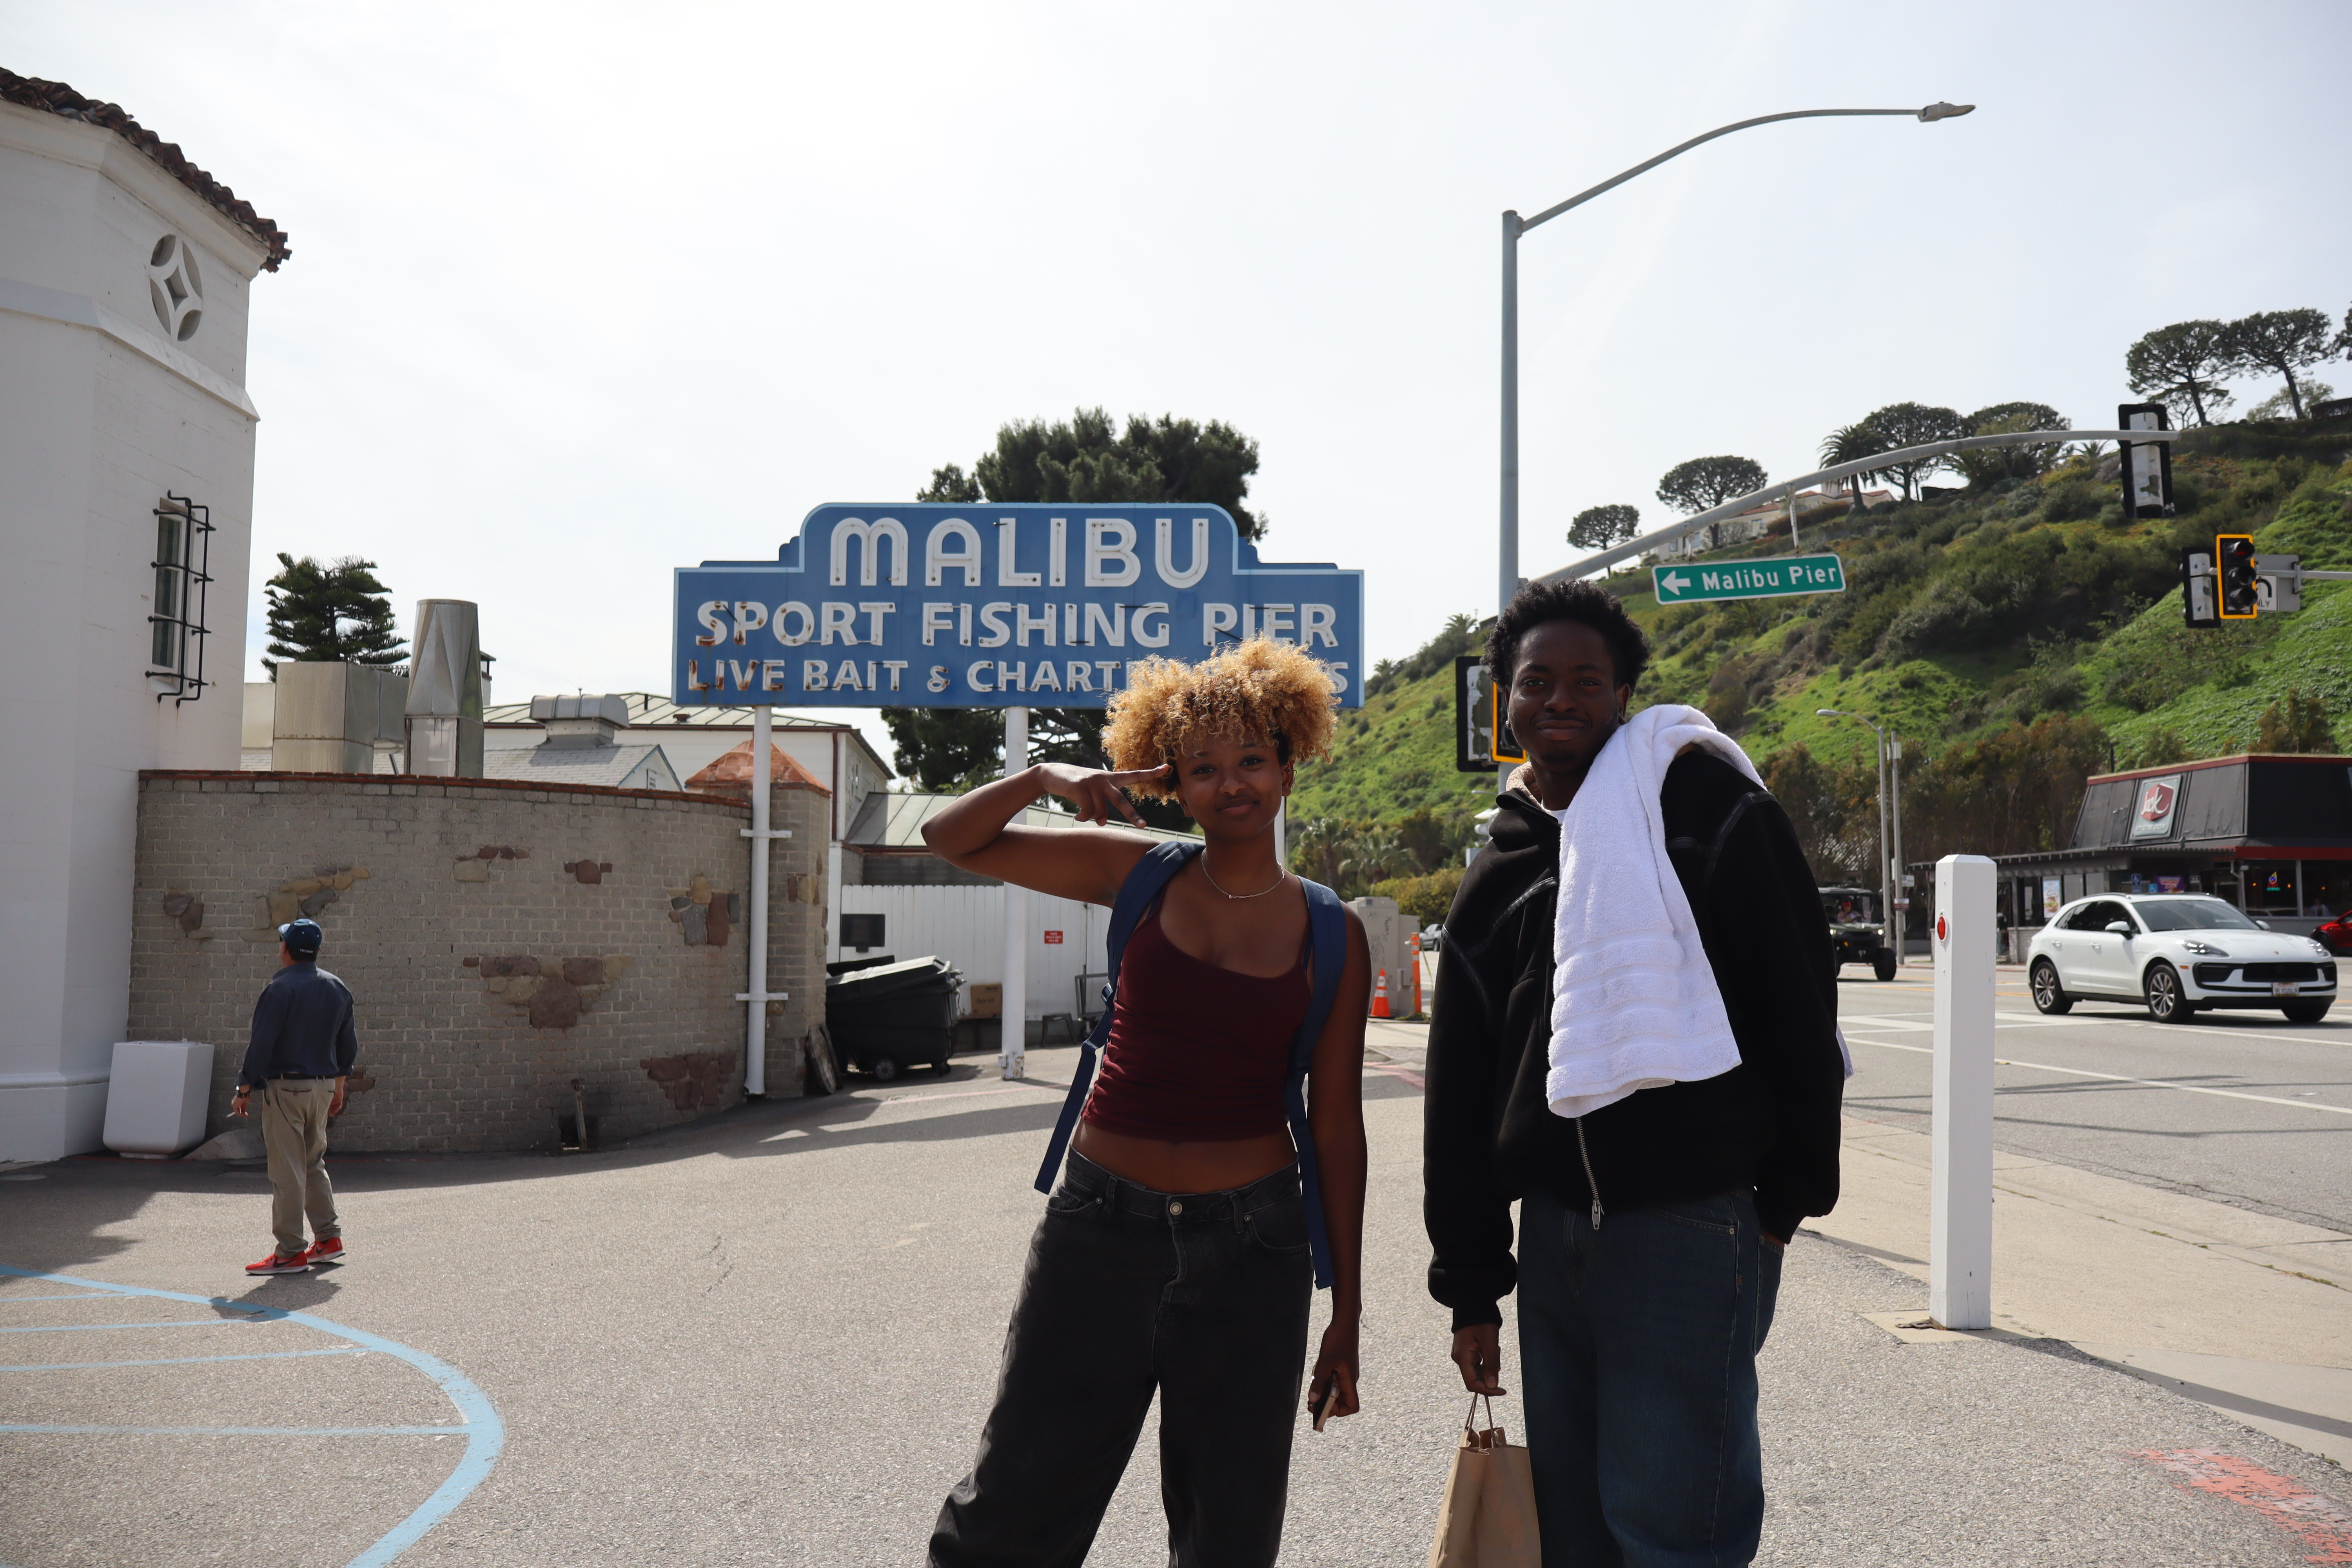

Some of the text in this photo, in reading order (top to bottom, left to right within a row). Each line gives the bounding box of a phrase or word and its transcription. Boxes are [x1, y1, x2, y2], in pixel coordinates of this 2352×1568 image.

[830, 517, 1209, 589] MALIBU
[1702, 565, 1836, 591] Malibu Pier
[696, 601, 1339, 648] SPORT FISHING PIER
[688, 659, 1133, 692] LIVE BAIT & CHART
